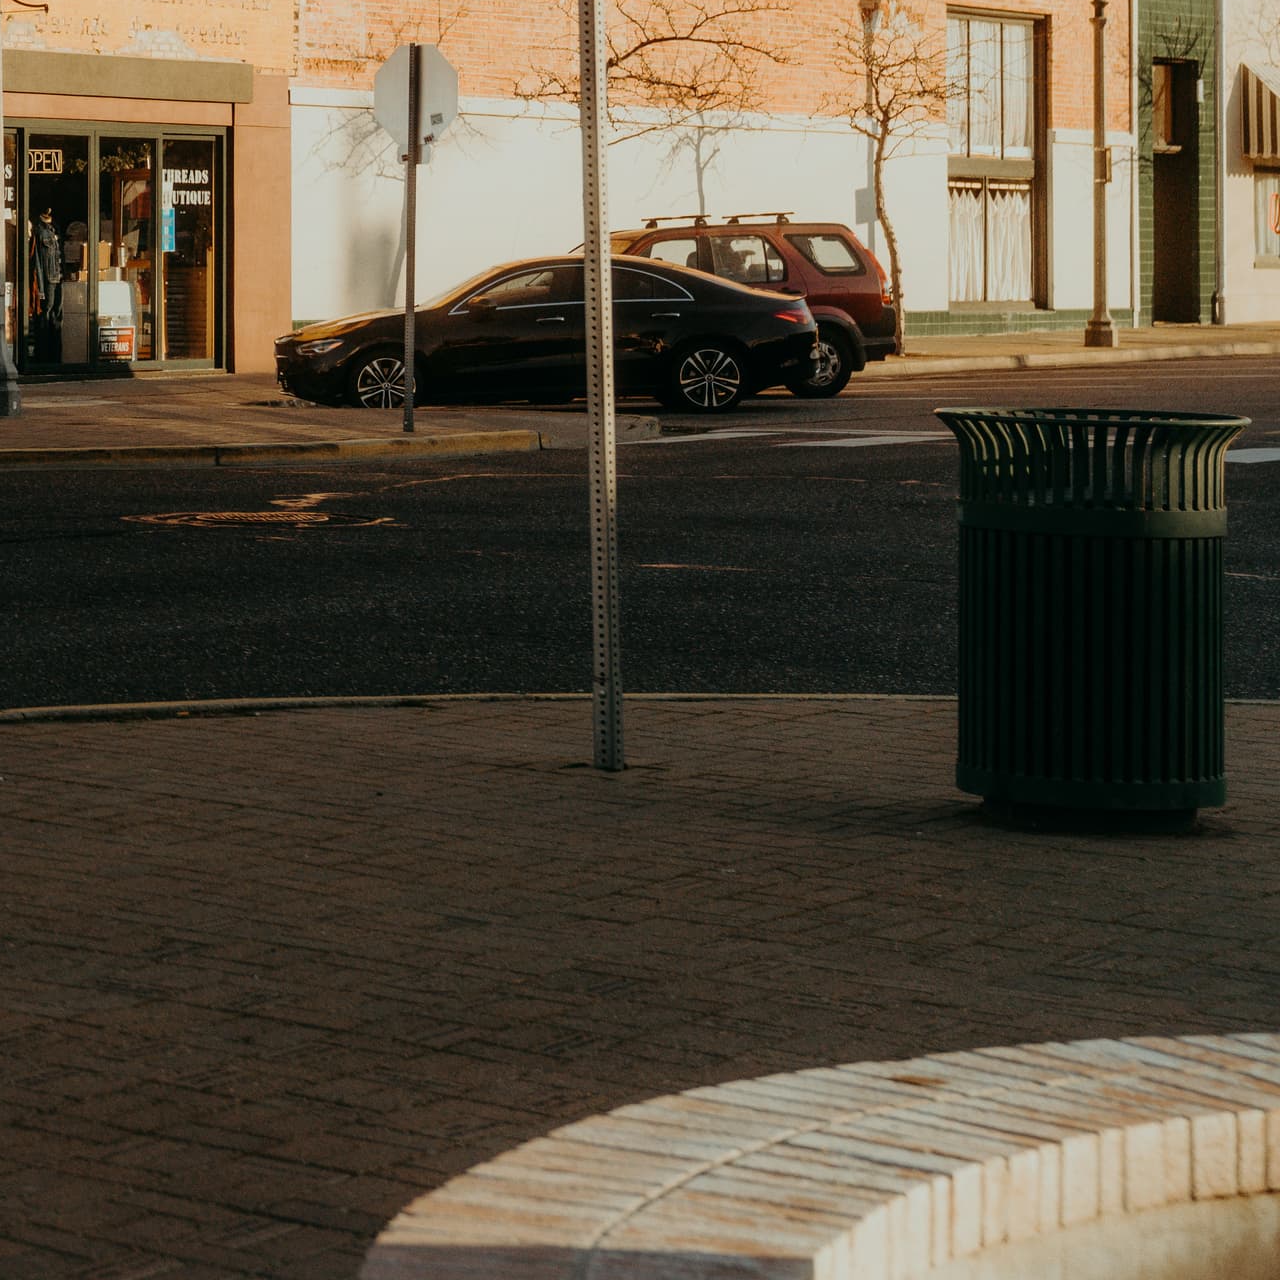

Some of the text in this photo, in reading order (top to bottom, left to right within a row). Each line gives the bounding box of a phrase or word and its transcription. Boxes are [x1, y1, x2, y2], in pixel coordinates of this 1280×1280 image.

[28, 150, 61, 171] OPEN
[162, 168, 209, 184] THREADS
[172, 190, 211, 206] UTIQUE
